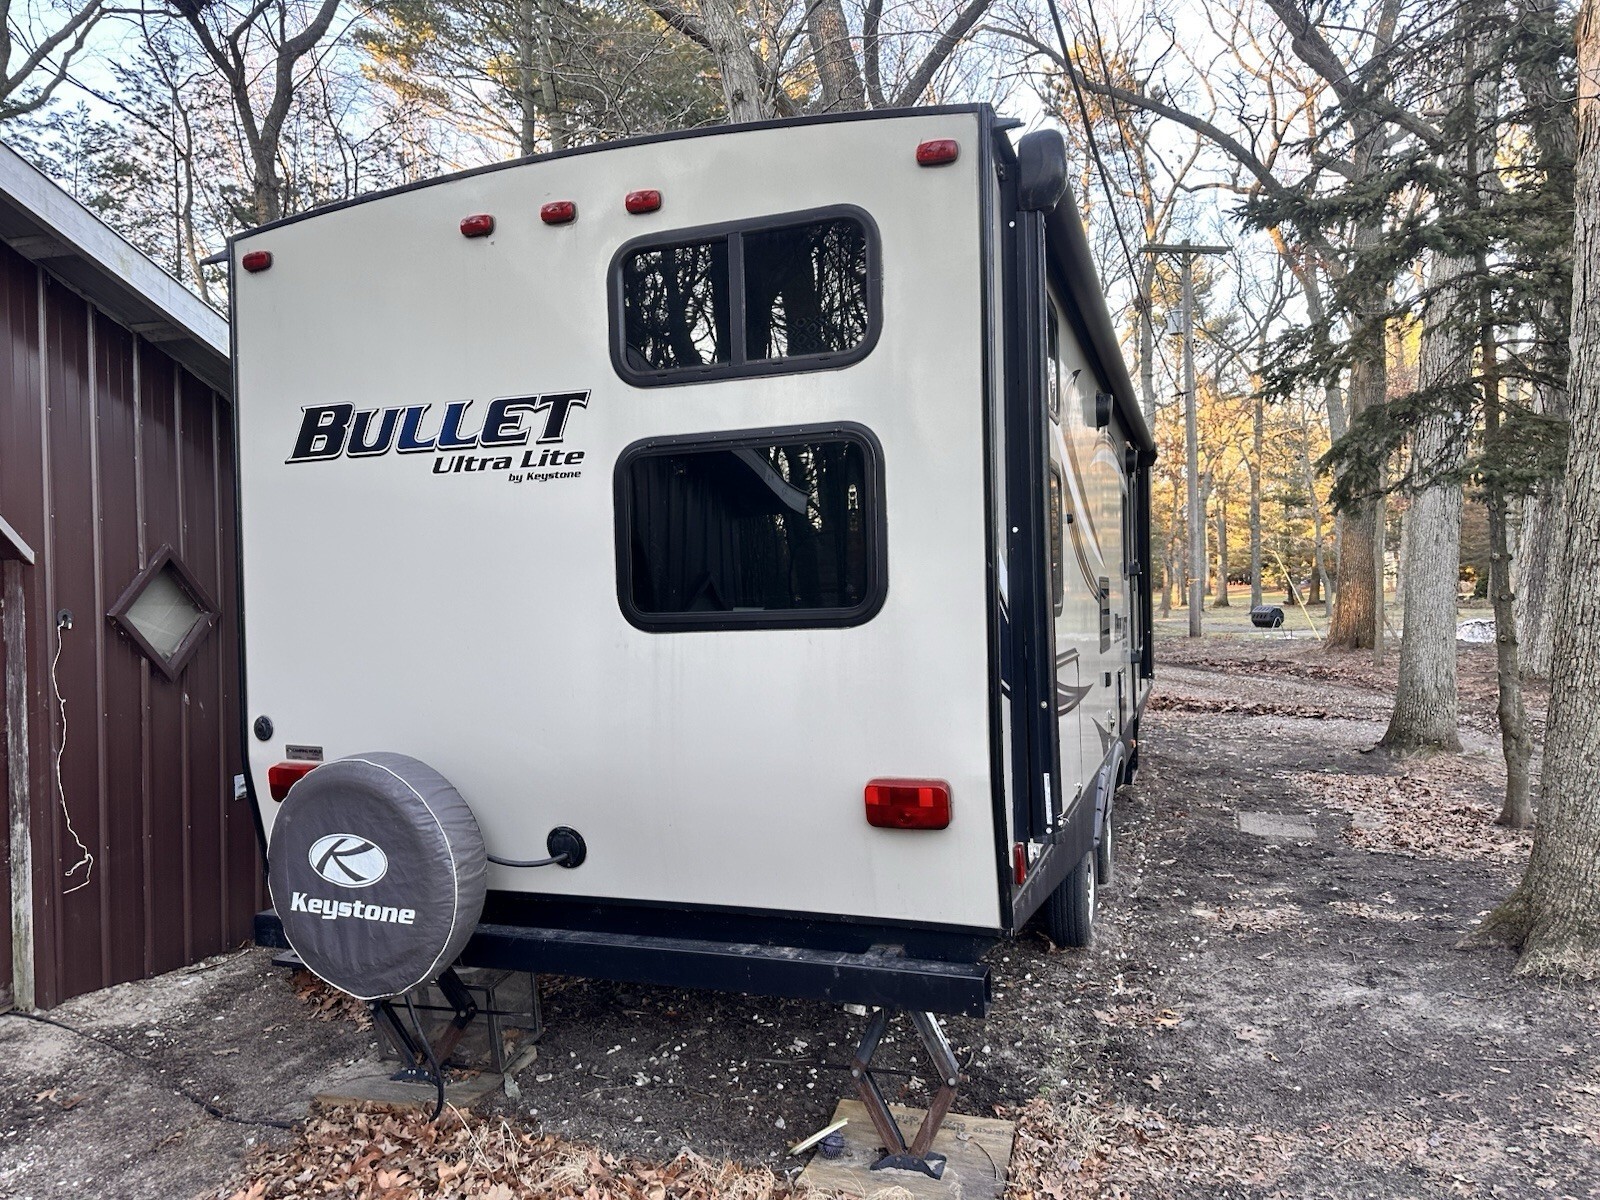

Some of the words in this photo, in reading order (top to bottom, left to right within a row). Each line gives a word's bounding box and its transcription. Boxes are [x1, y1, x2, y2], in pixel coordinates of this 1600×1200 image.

[285, 389, 591, 464] BULLET
[432, 455, 513, 474] Ultra
[520, 450, 585, 468] Lite
[508, 473, 523, 483] by
[526, 471, 581, 483] Keystone
[290, 891, 416, 925] Keystone
